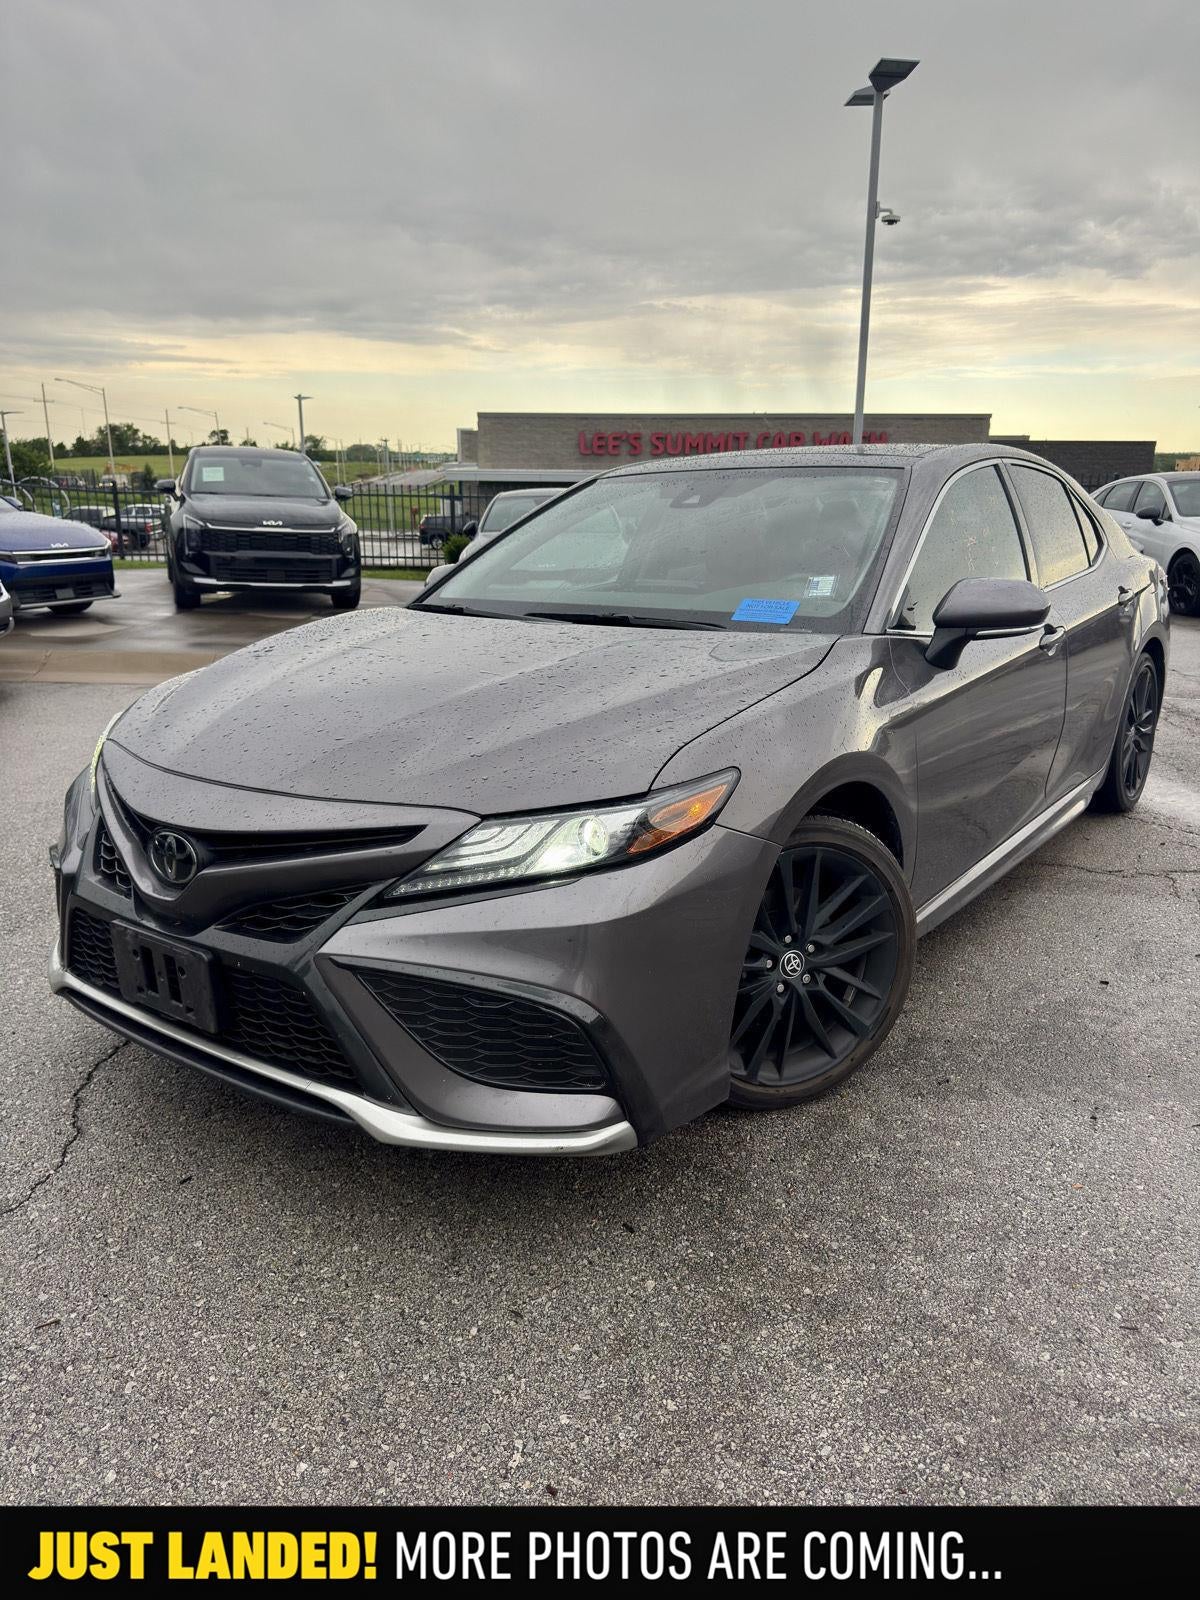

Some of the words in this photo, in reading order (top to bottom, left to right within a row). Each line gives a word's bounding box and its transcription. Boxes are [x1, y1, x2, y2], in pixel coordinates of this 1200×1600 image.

[577, 431, 641, 456] LEE'S
[650, 431, 749, 456] SUMMIT
[756, 431, 806, 450] CAR
